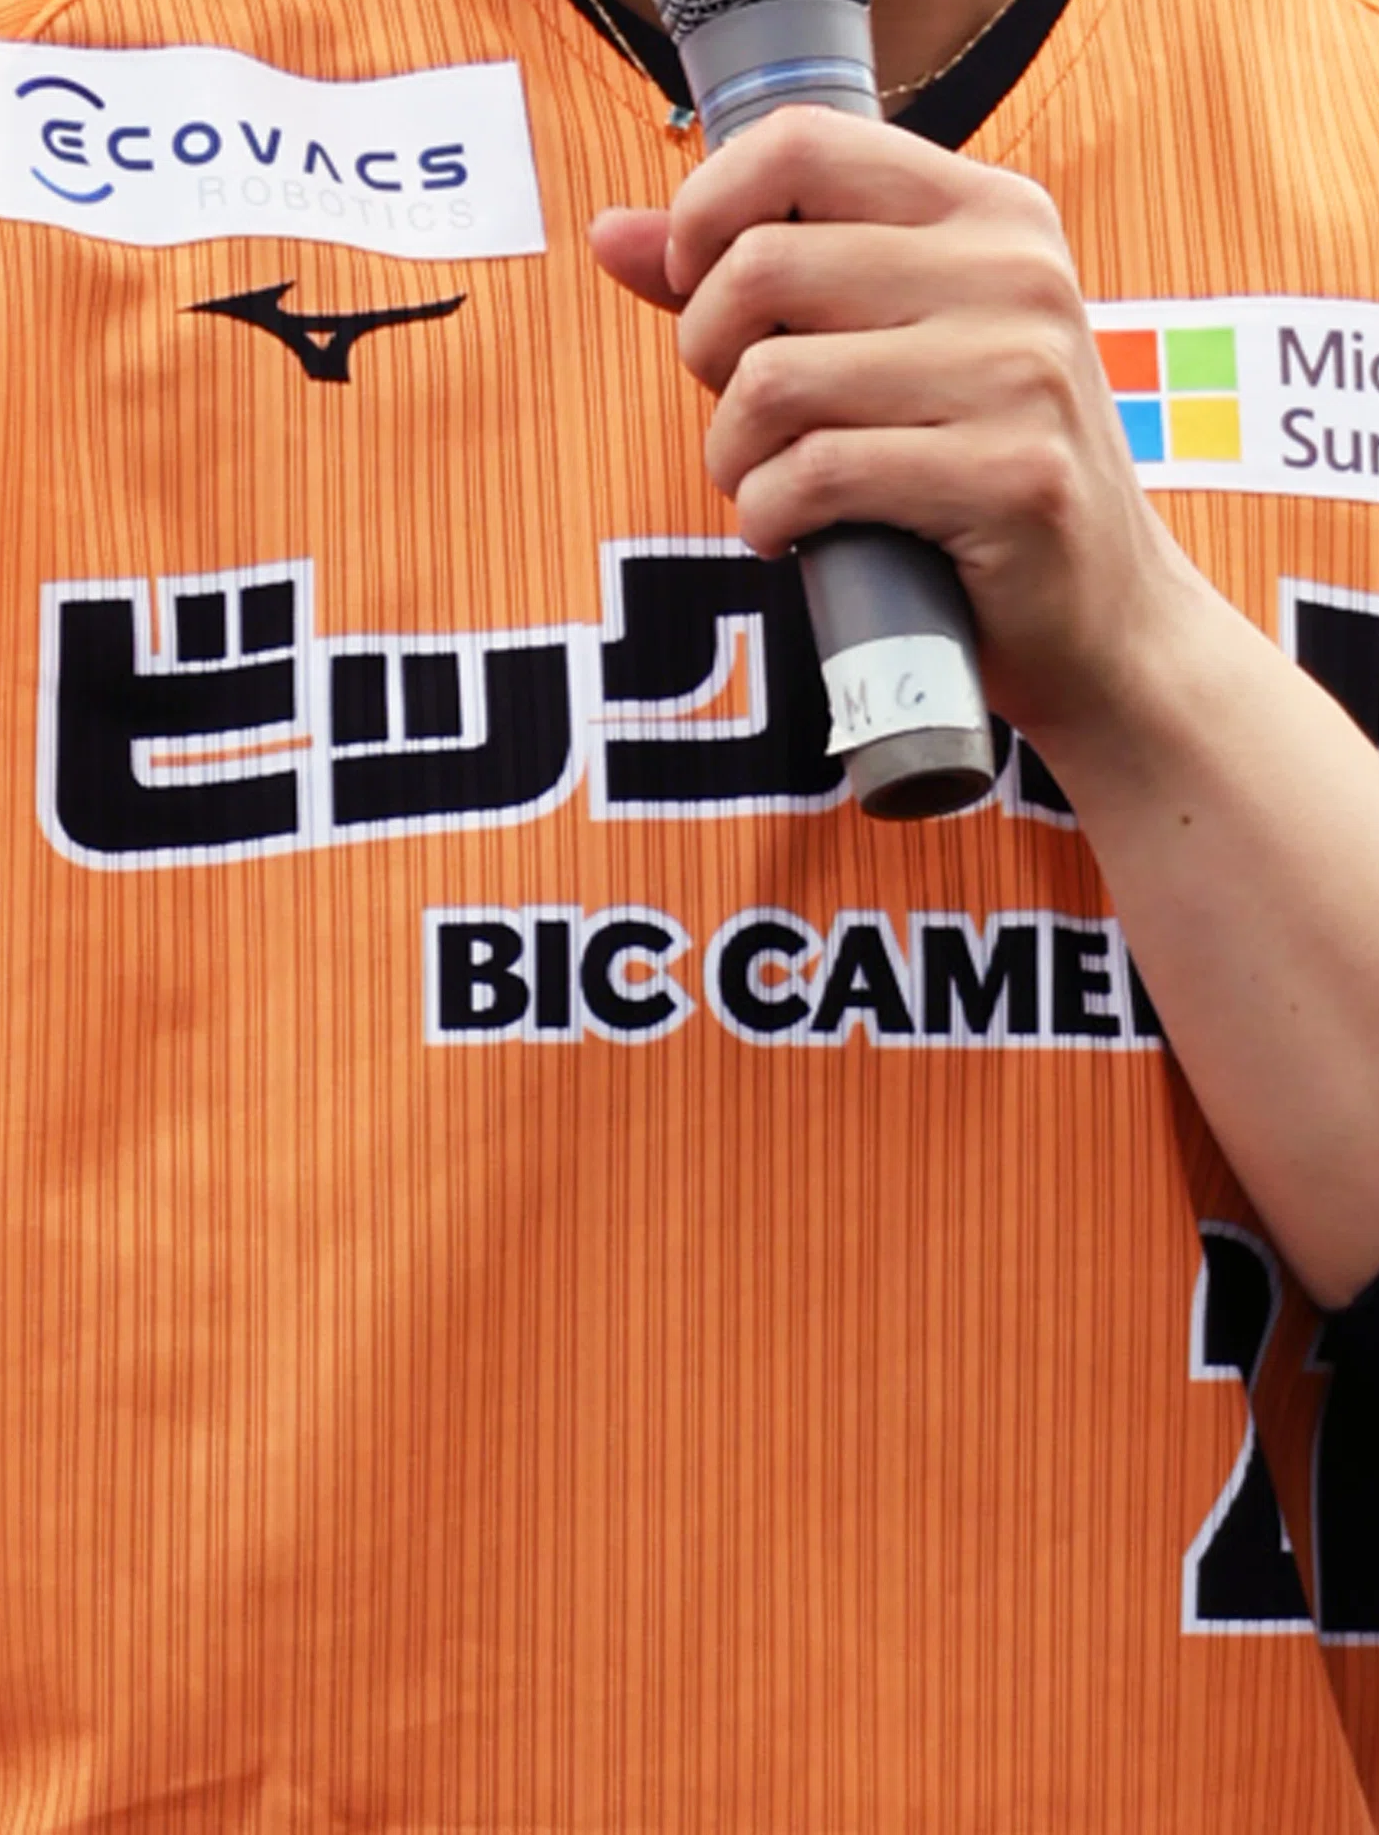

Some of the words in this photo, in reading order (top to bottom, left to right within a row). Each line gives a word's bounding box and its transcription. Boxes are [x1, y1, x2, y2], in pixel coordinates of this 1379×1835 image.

[197, 176, 476, 232] ROBOTICS
[427, 909, 694, 1045] BIC
[706, 910, 1168, 1051] CAME
